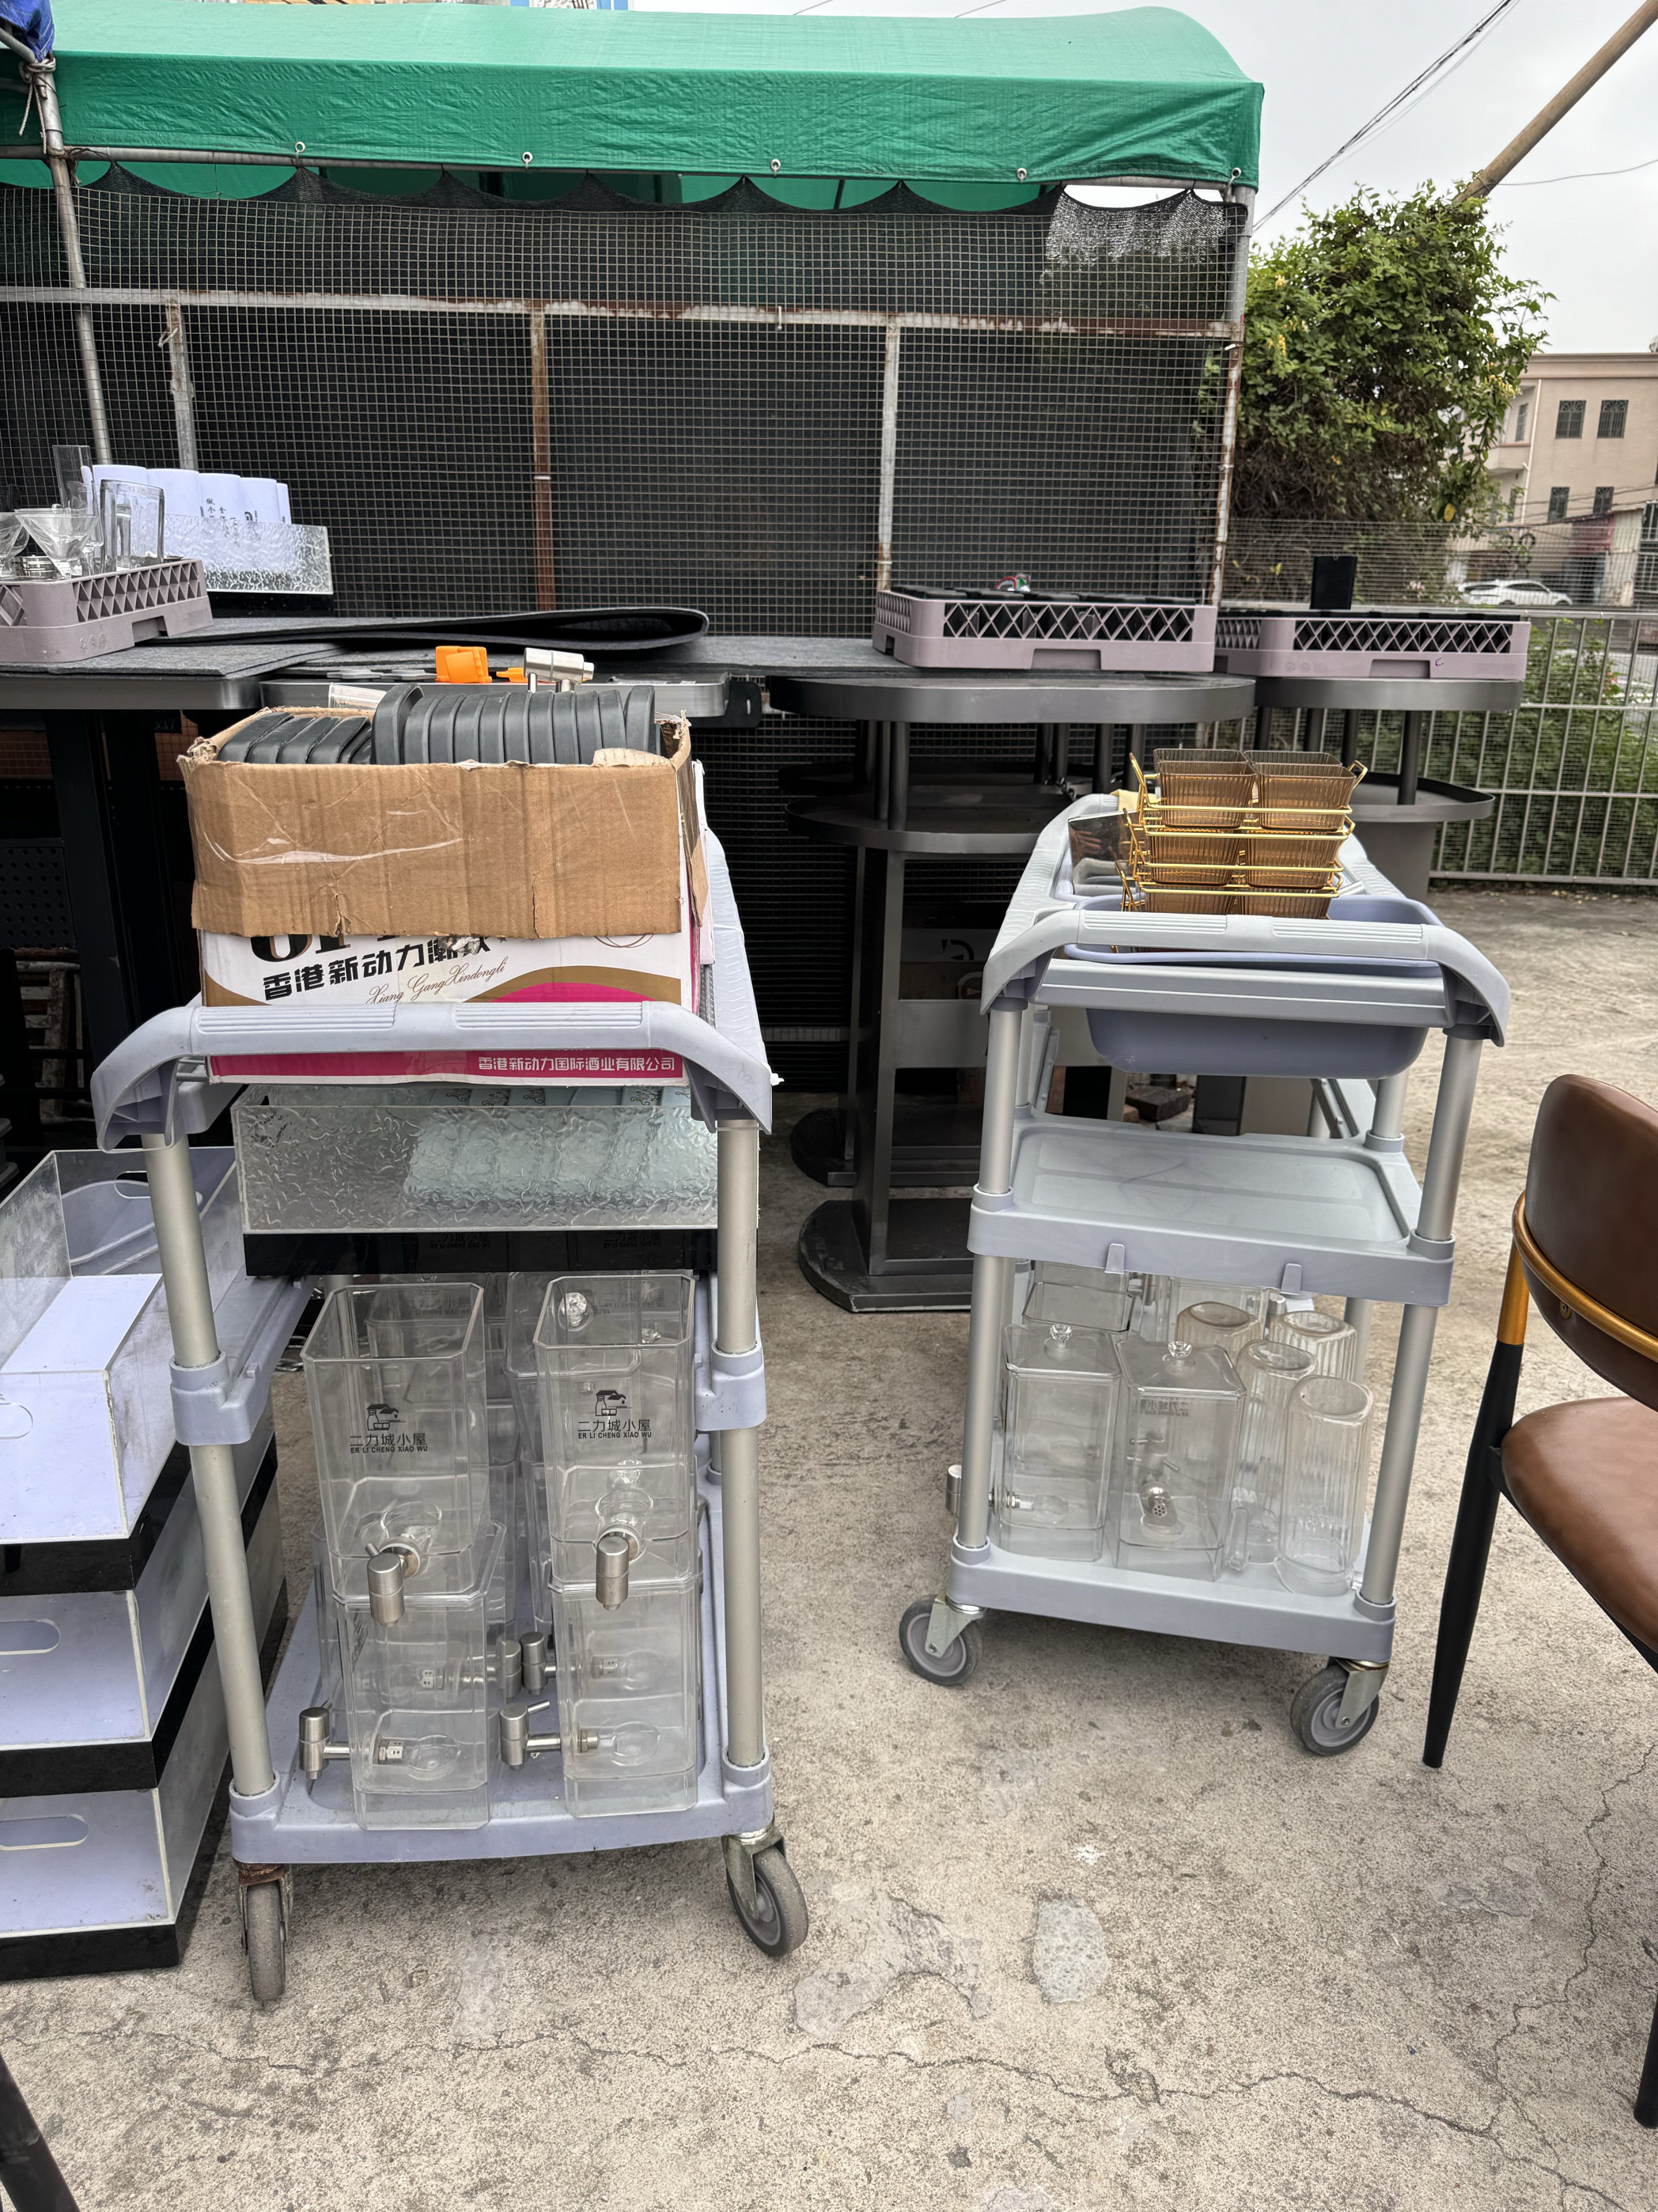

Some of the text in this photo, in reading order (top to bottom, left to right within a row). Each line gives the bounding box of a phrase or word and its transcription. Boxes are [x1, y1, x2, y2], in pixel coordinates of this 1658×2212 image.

[478, 1057, 675, 1071] 香港新动力国际酒业有限公司
[577, 1419, 651, 1432] 二力城小屋
[350, 1433, 427, 1446] 二力城小屋
